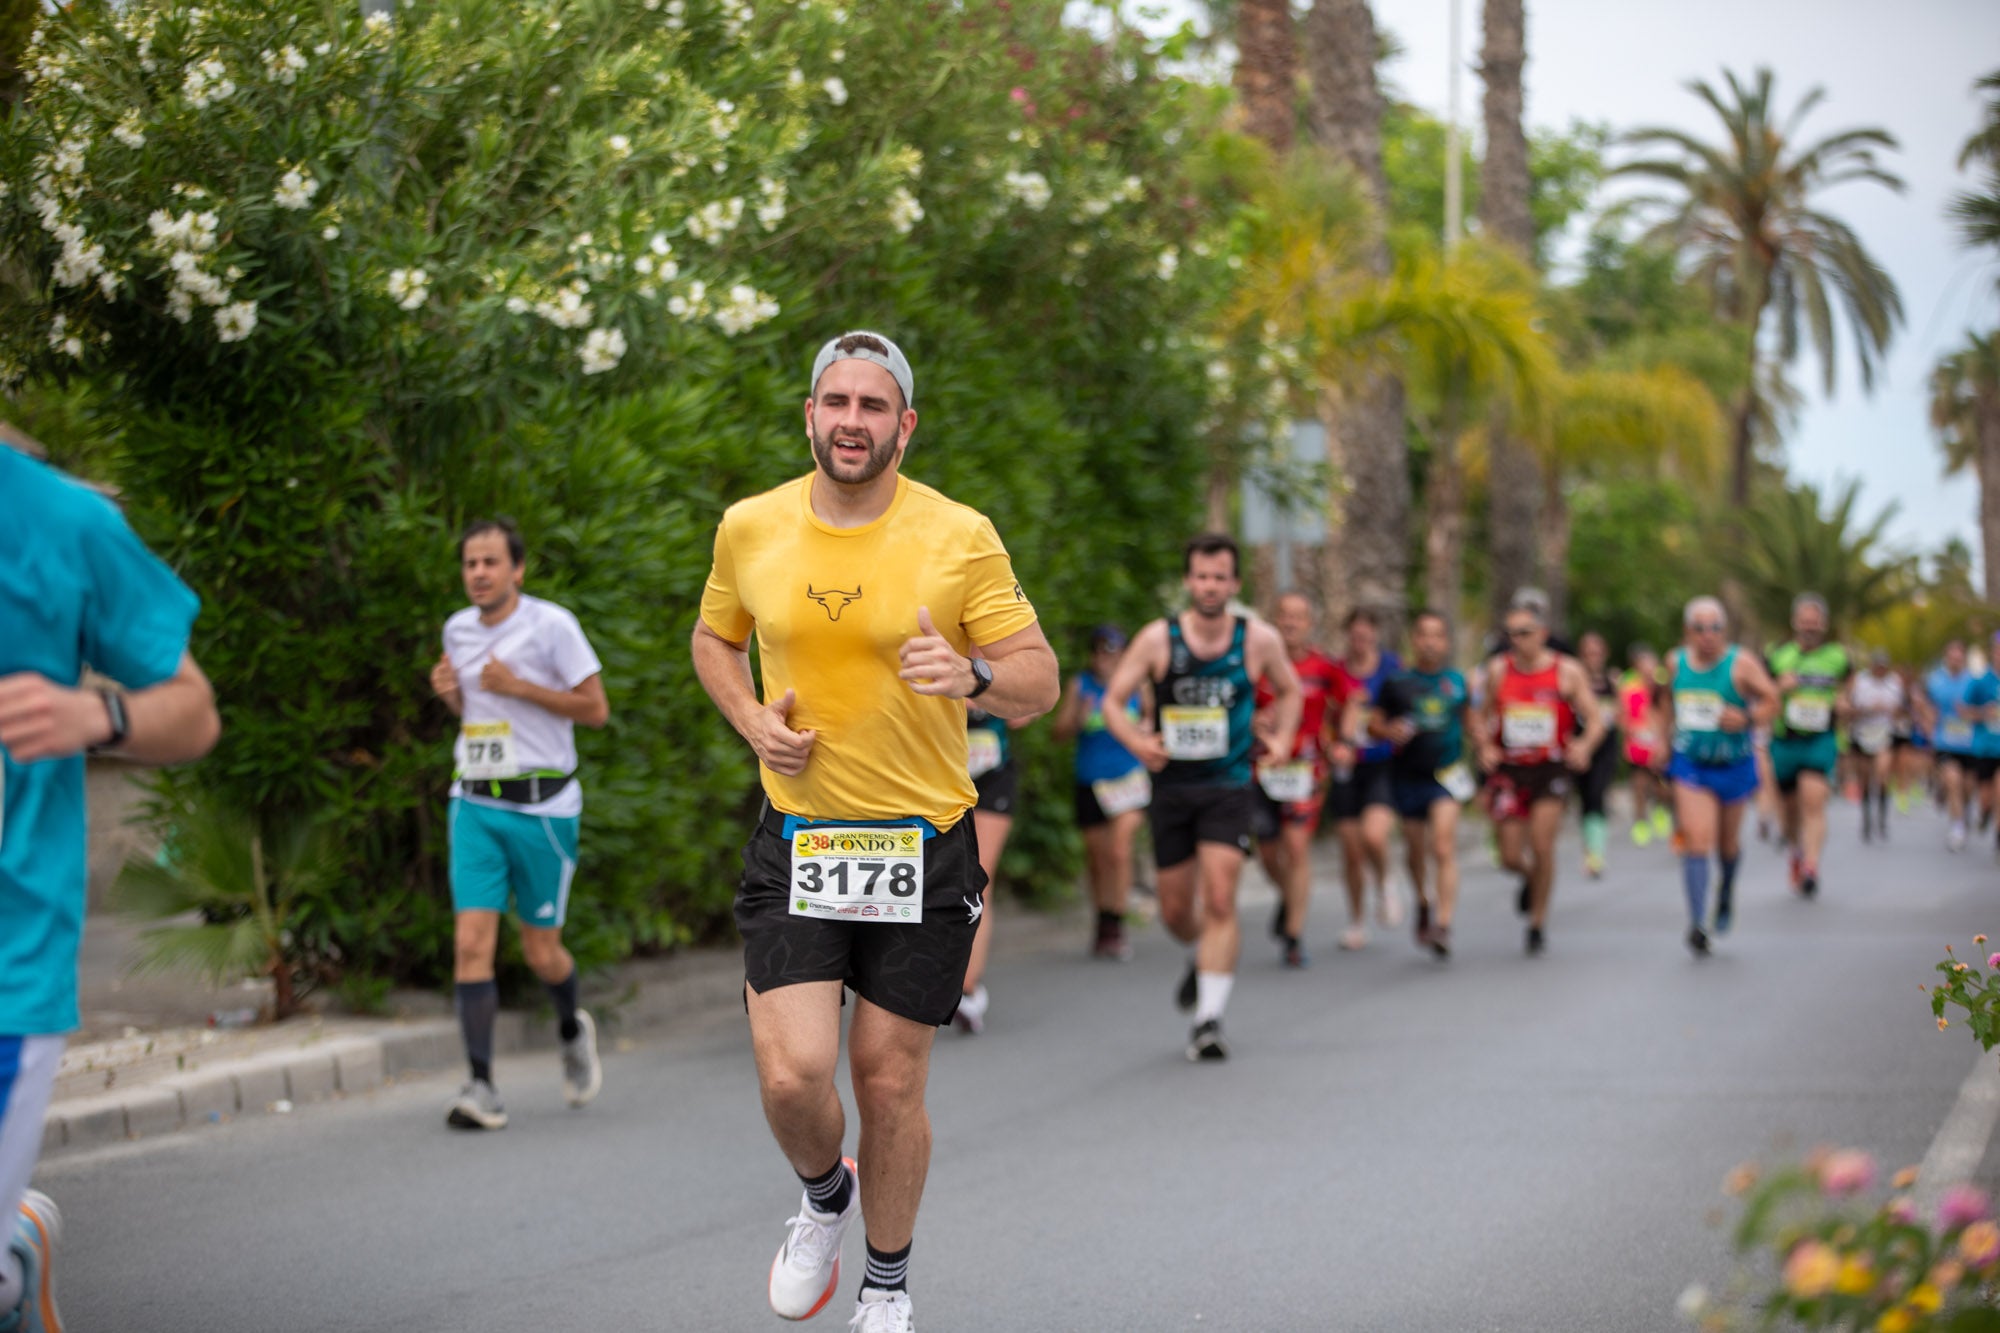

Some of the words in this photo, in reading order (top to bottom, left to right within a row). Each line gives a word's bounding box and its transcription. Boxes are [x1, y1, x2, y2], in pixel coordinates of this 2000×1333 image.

[811, 835, 829, 850] 38
[830, 839, 895, 851] FONDO
[797, 861, 917, 897] 3178
